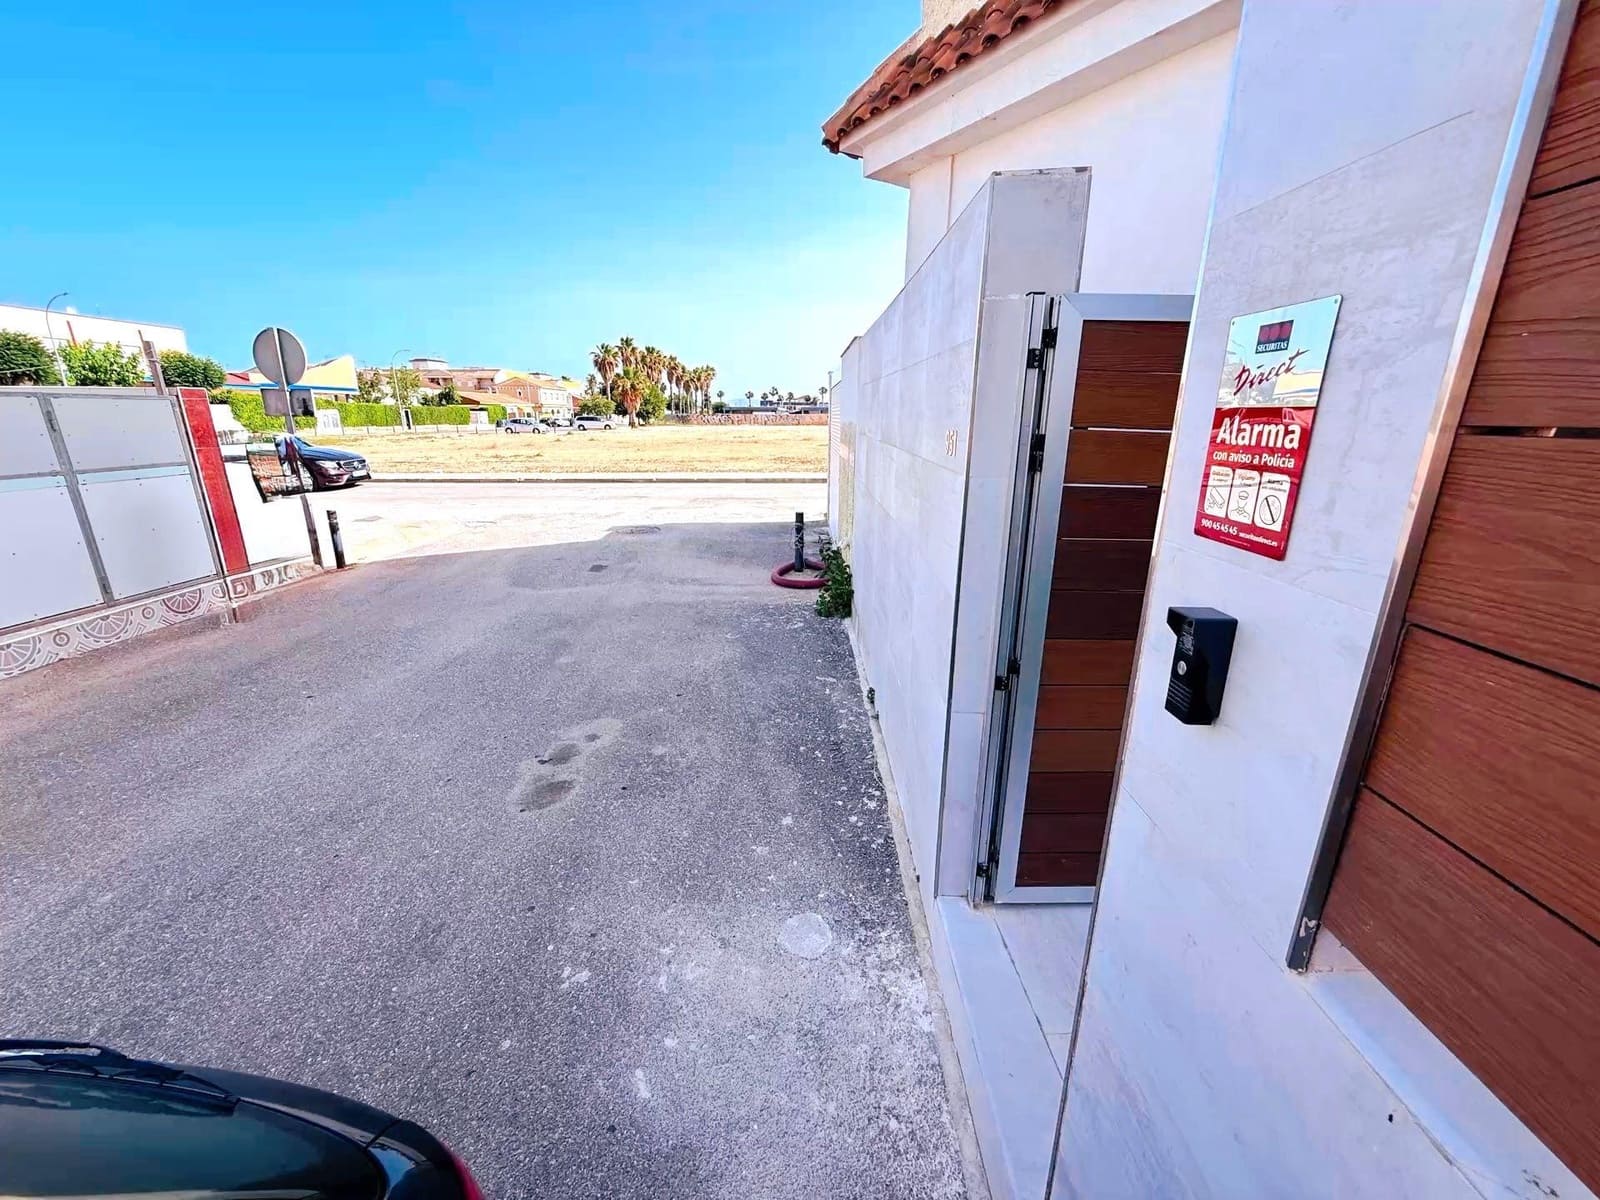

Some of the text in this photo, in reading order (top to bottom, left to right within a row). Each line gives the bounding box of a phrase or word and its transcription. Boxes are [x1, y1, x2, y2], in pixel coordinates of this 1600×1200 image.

[1257, 341, 1288, 352] SECURITAS
[1233, 348, 1310, 396] Direct
[1216, 415, 1301, 450] Alarma
[1213, 450, 1295, 468] con aviso a Policía
[1201, 518, 1213, 529] 900
[1229, 526, 1238, 535] 45
